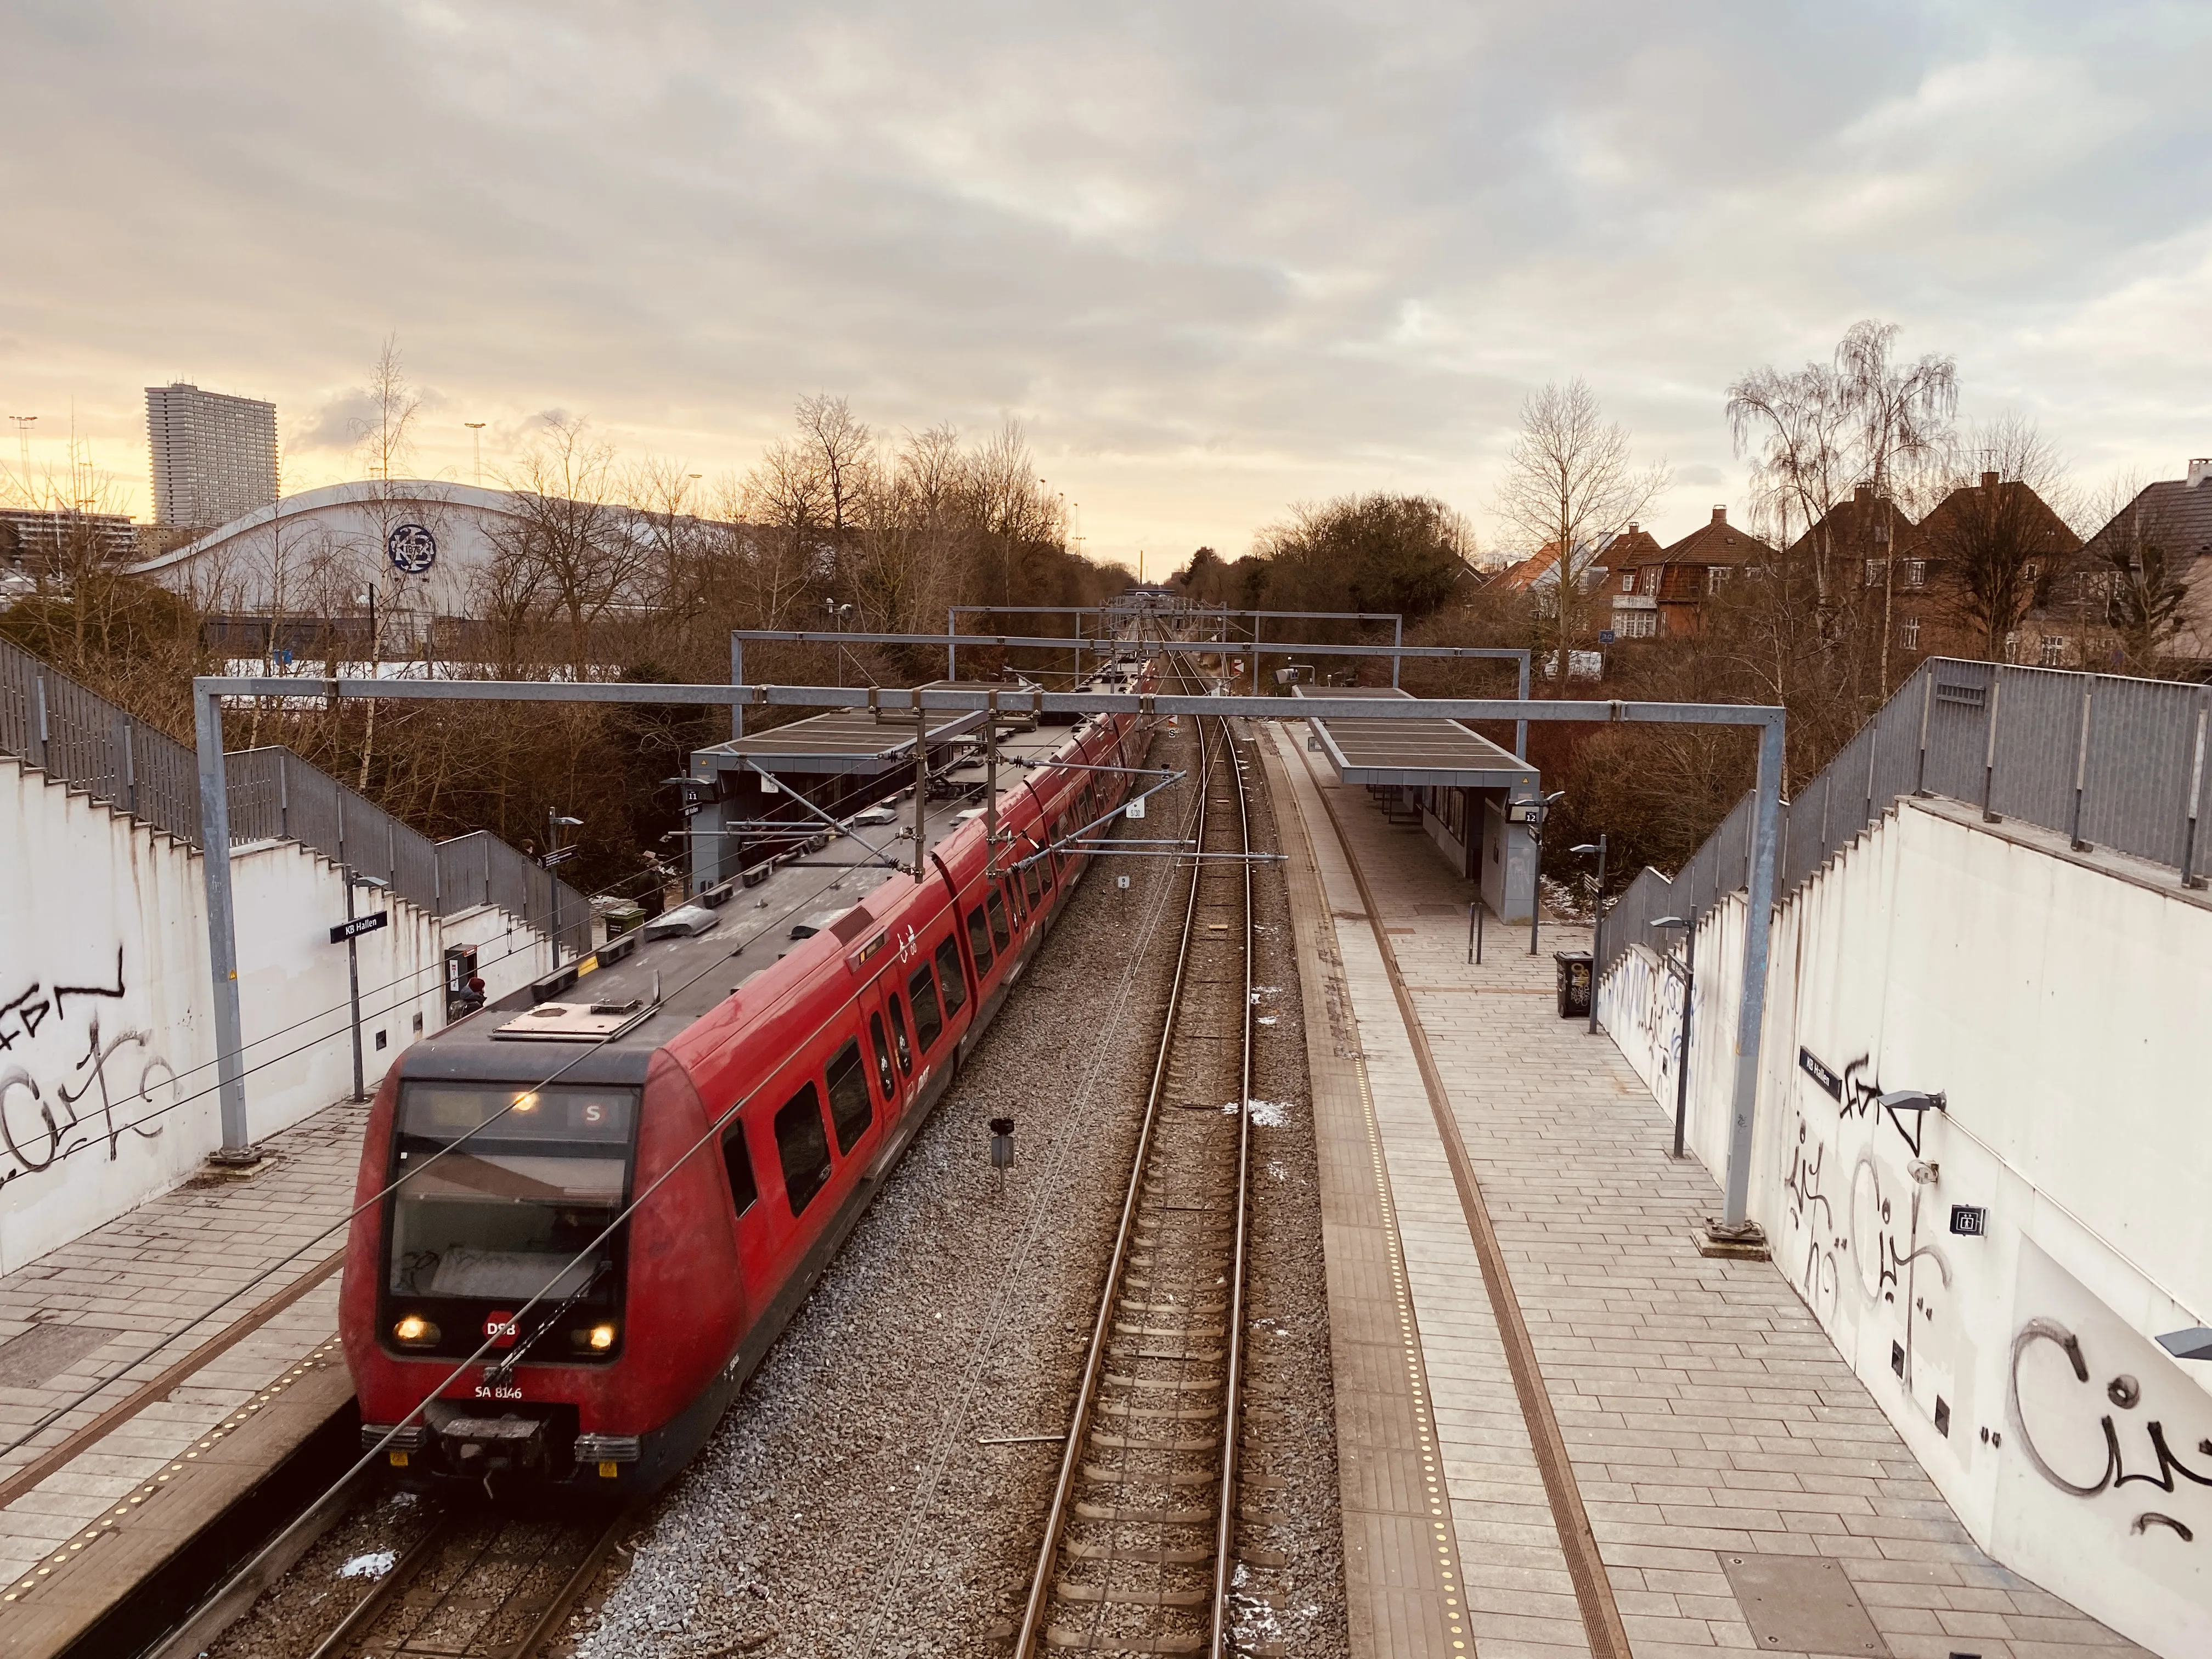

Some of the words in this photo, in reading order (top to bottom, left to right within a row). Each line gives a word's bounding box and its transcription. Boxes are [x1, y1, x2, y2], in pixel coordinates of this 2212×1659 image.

[346, 924, 354, 935] KB
[356, 918, 377, 932] Hallen
[1807, 1056, 1814, 1071] KB
[1814, 1063, 1830, 1087] Hallen
[586, 1105, 601, 1121] S
[475, 1386, 491, 1397] SA
[495, 1386, 522, 1399] 8146
